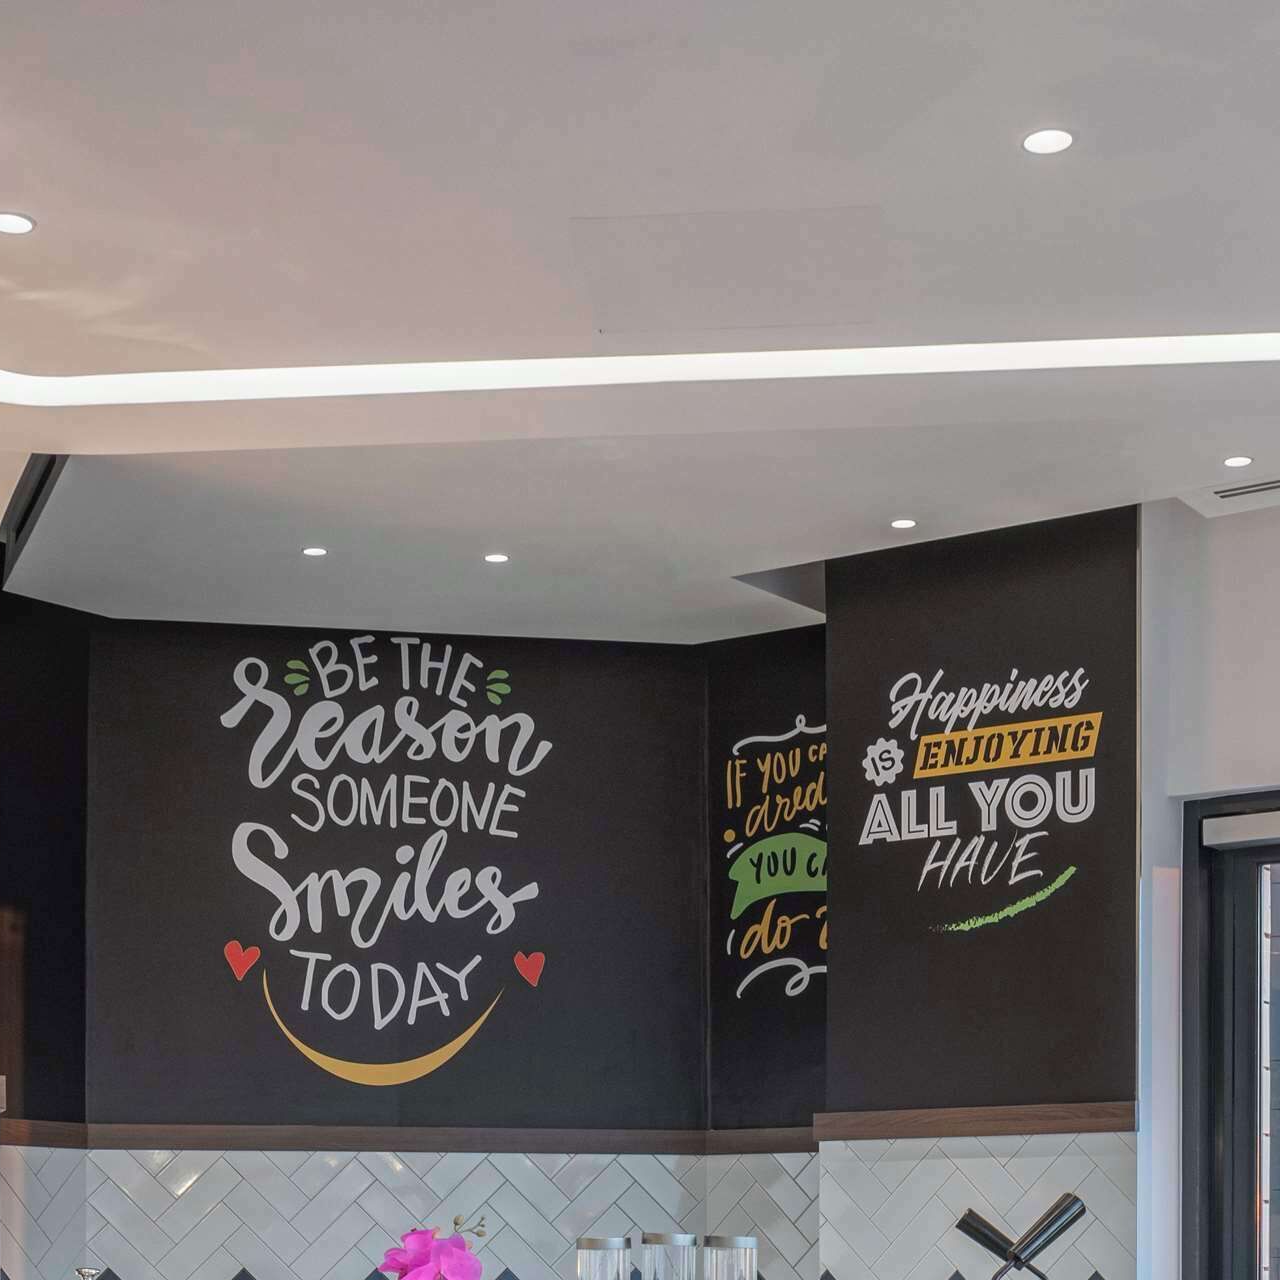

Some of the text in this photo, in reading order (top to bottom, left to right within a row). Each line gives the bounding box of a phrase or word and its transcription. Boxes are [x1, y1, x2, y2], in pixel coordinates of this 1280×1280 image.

[309, 635, 483, 707] BE THE
[888, 667, 1089, 740] Happiness
[220, 657, 552, 789] reason
[920, 718, 1095, 771] ENJOYING
[727, 759, 747, 809] IF
[757, 748, 801, 793] YOU
[870, 748, 896, 777] IS
[291, 773, 526, 838] SOMEONE
[858, 767, 1096, 846] ALL YOU
[231, 822, 539, 948] Smiles
[749, 847, 797, 884] YOU
[917, 830, 1050, 891] HAVE
[740, 898, 810, 959] do
[289, 949, 482, 1030] TODAY
